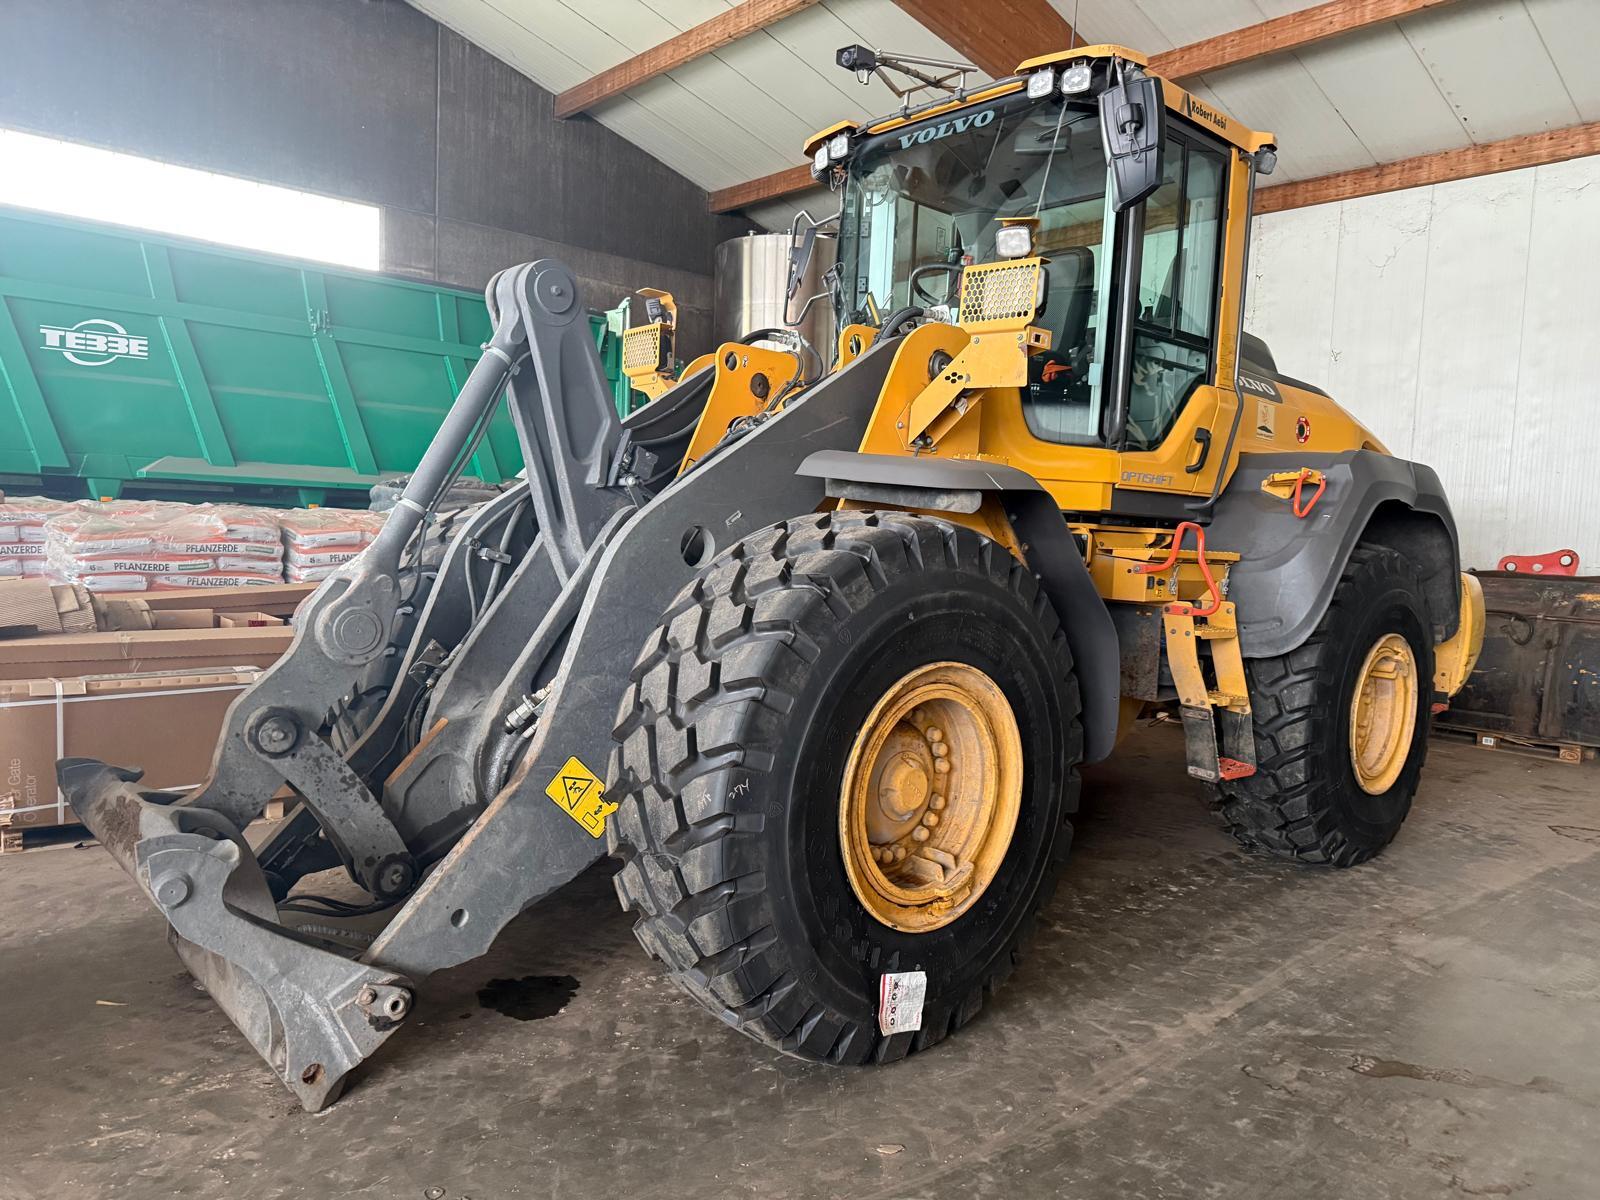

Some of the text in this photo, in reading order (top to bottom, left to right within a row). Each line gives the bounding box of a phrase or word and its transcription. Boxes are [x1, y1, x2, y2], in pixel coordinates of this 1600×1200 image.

[1192, 101, 1212, 122] Robert
[898, 110, 995, 149] VOLVO
[40, 328, 148, 356] TEBBE
[1121, 471, 1175, 486] OPTISHIFT
[185, 544, 239, 553] PFLANZERDE
[114, 562, 170, 571] PFLANZERDE
[186, 577, 240, 586] PFLANZERDE
[8, 758, 21, 786] Gate
[24, 774, 37, 822] Oerator
